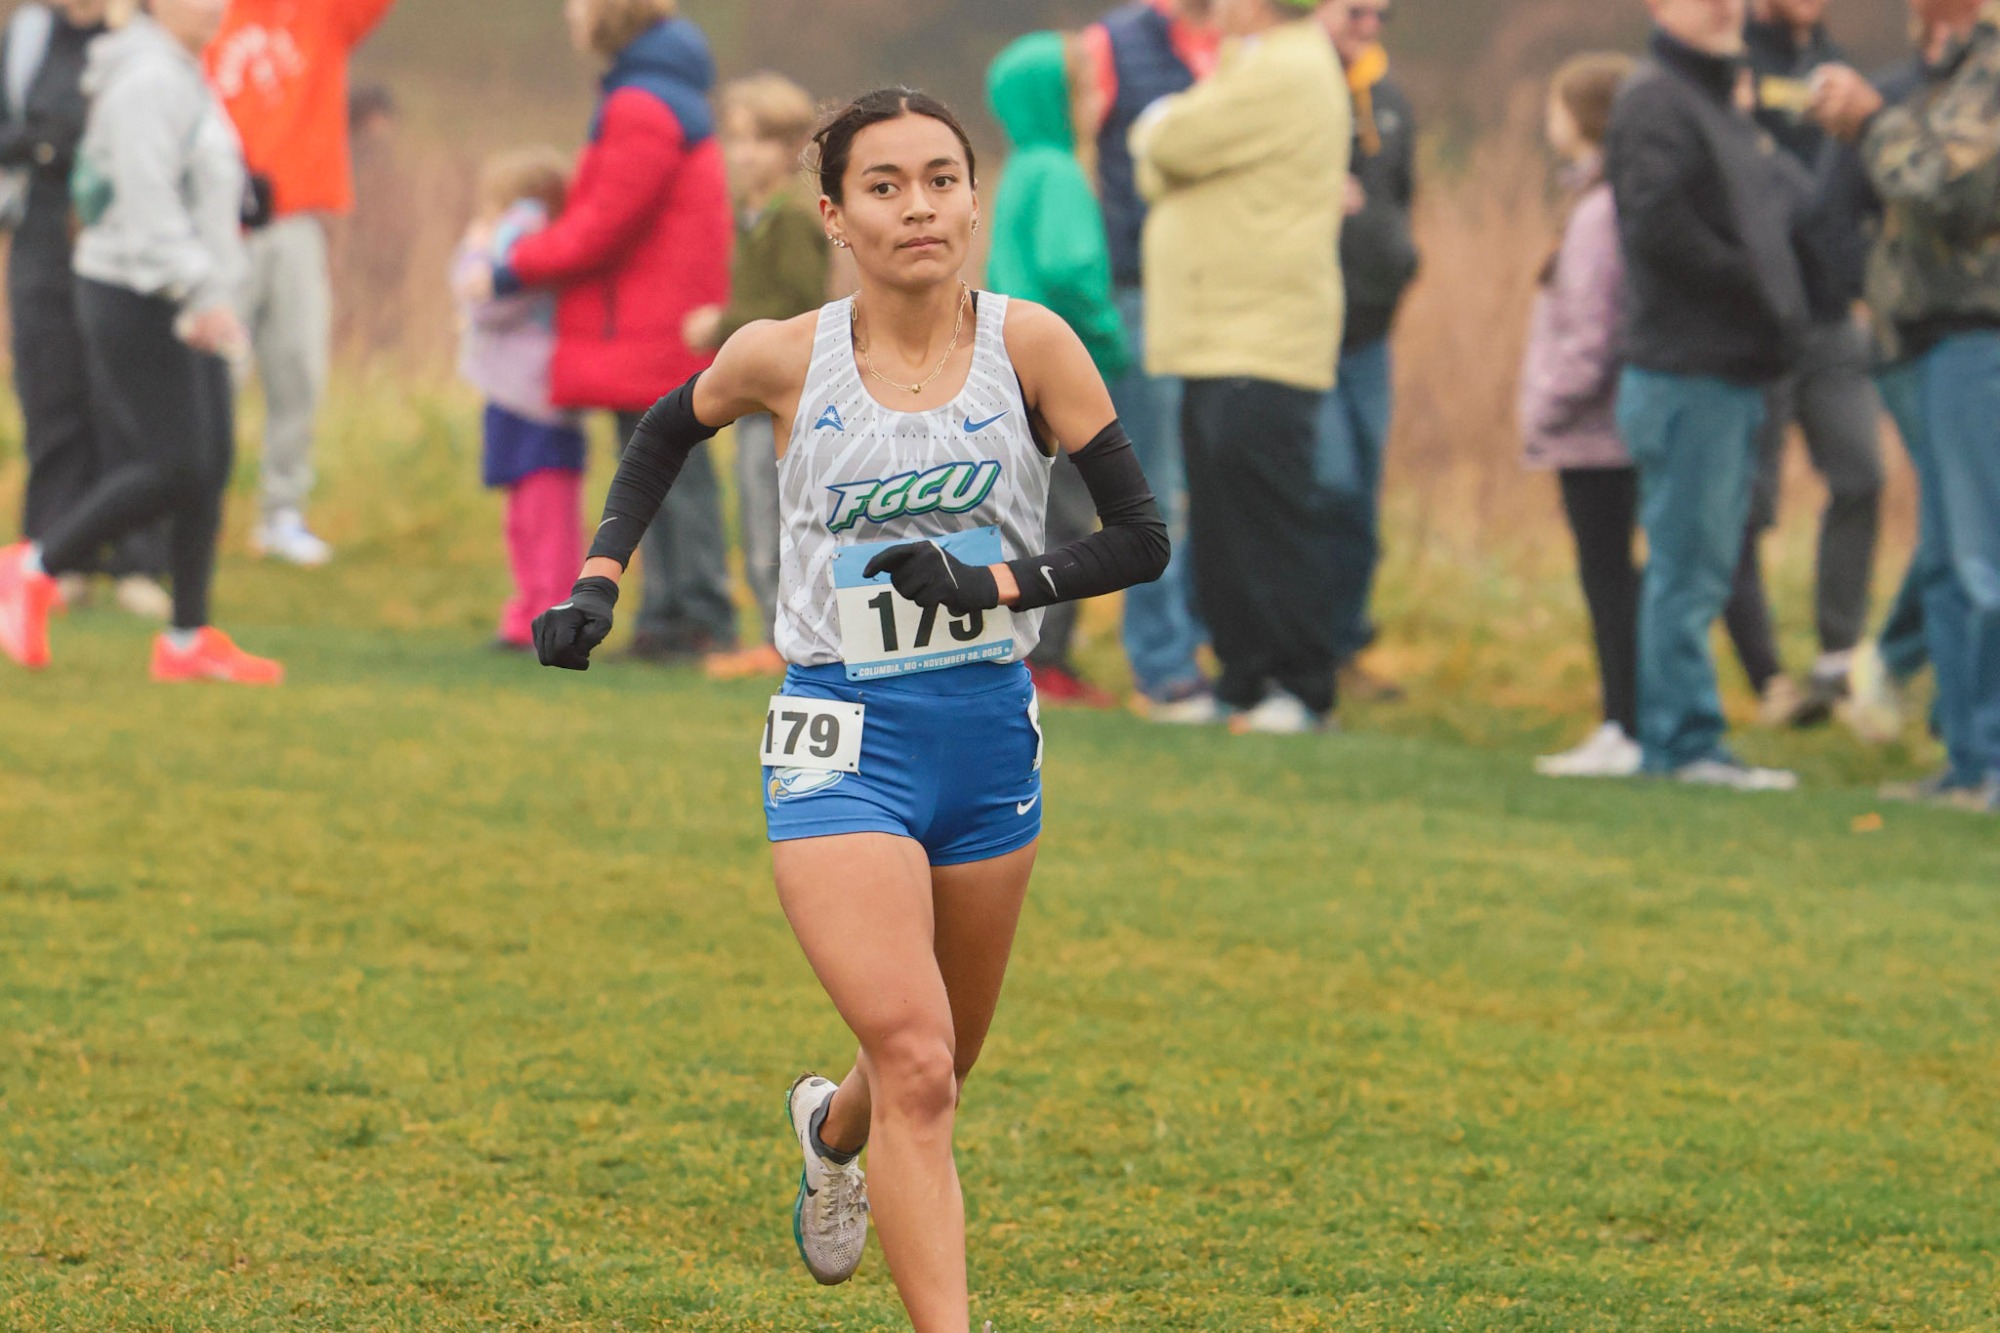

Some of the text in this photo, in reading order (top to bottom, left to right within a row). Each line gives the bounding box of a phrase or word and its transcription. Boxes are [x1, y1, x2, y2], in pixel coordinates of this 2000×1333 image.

[826, 460, 1002, 533] FGCU
[859, 664, 901, 677] COLUMBIA,
[904, 662, 917, 671] MO
[923, 654, 966, 668] NOVEMBER
[982, 646, 1002, 658] 2025
[765, 710, 840, 758] 179
